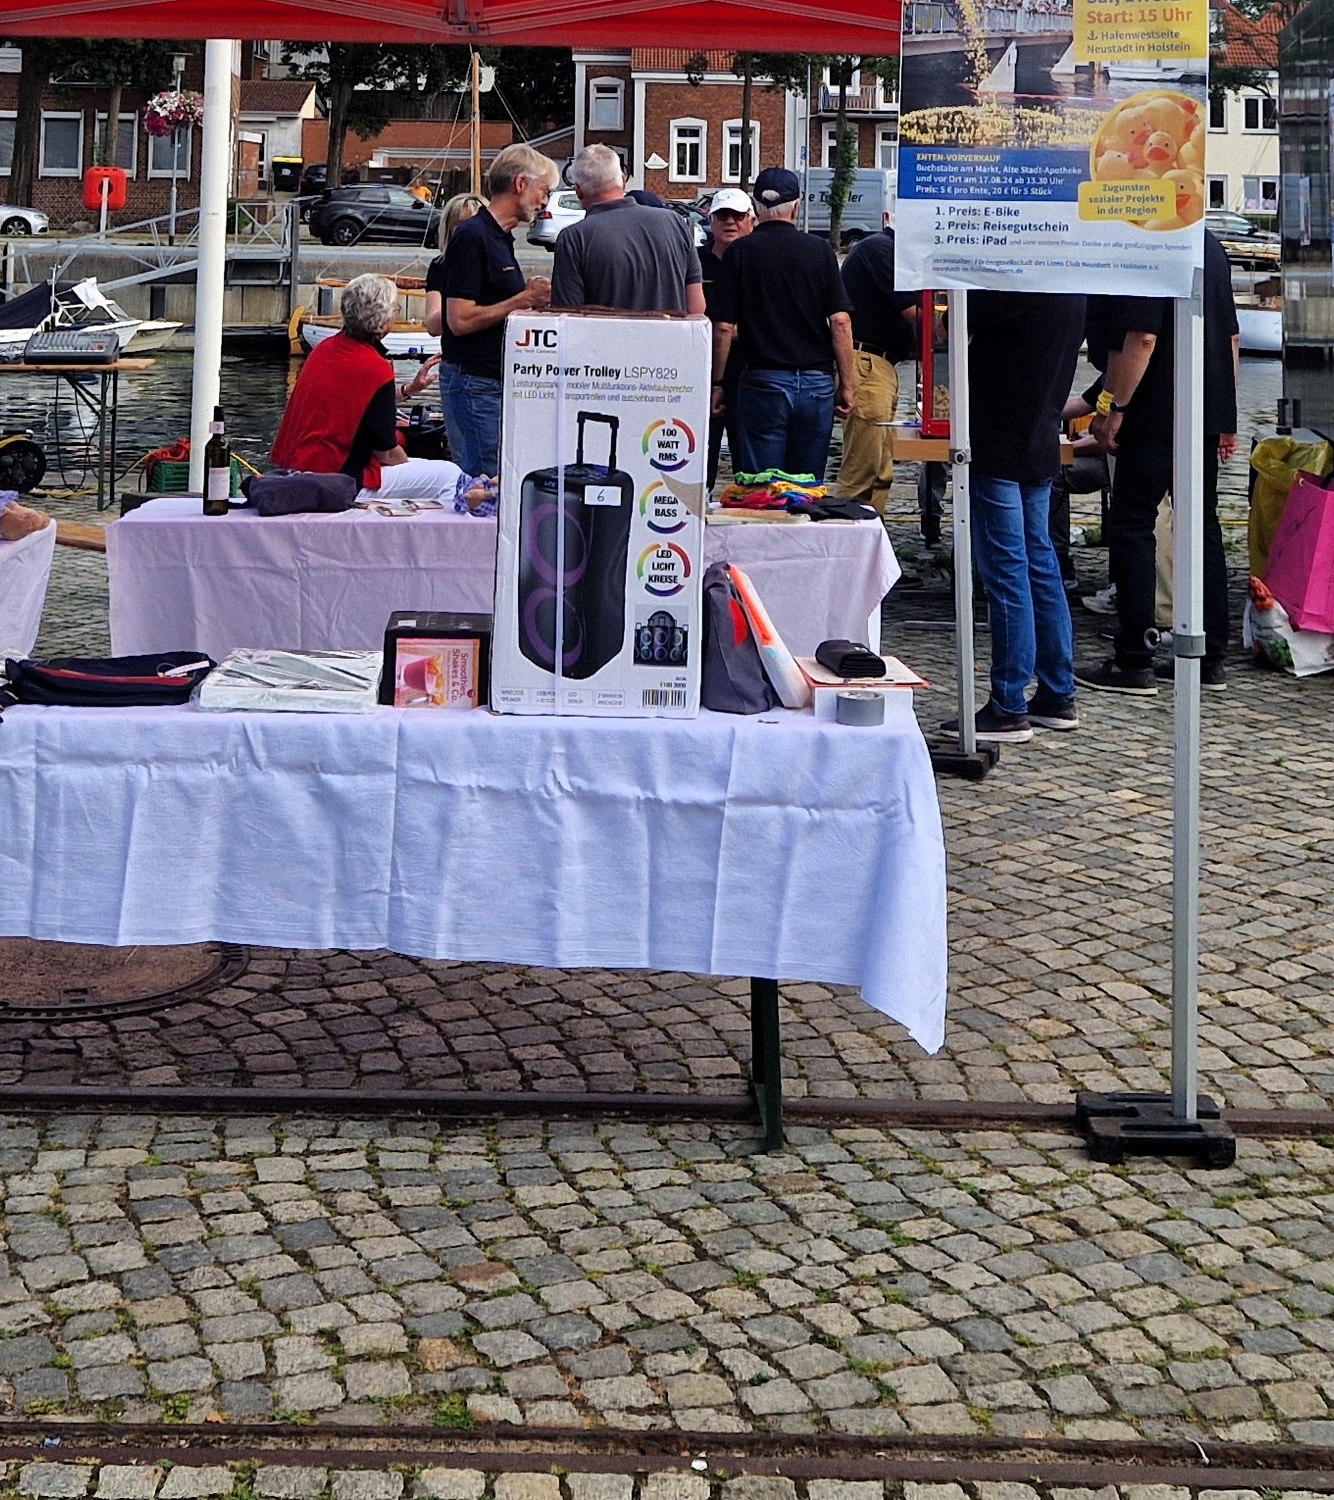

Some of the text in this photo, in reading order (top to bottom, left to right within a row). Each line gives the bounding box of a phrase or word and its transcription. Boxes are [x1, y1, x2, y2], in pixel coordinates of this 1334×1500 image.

[1086, 7, 1193, 25] Start: 15 Uhr
[1100, 30, 1181, 41] Hafenwestseite
[1086, 41, 1191, 54] Neustadt in Holstein
[915, 164, 958, 173] Buchstabe
[975, 165, 1001, 175] Markt,
[1003, 166, 1019, 174] Alte
[1020, 166, 1083, 176] Stadt-Apotheke
[915, 174, 932, 183] und
[933, 176, 947, 184] vor
[948, 175, 962, 184] Ort
[1049, 176, 1065, 185] Uhr
[915, 185, 939, 194] Preis:
[953, 188, 968, 196] pro
[969, 186, 991, 196] Ente,
[992, 186, 1002, 195] 20
[1010, 186, 1023, 196] für
[1030, 186, 1053, 196] Stück
[1102, 183, 1150, 193] Zugunsten
[1089, 194, 1165, 205] sozialer Projekte
[935, 206, 1020, 217] 1. Preis: E-Bike
[1097, 206, 1158, 216] in der Region
[935, 221, 1069, 234] 2. Preis: Reisegutschein
[934, 235, 944, 245] 3.
[946, 235, 980, 245] Preis:
[982, 235, 1008, 246] iPad
[515, 329, 558, 348] JTC
[513, 362, 543, 378] Party
[583, 365, 621, 380] Trolley
[624, 366, 678, 380] LSPY829
[566, 381, 591, 390] mobiler
[524, 390, 538, 399] LED
[607, 394, 620, 402] und
[661, 428, 678, 437] 100
[657, 440, 680, 450] WATT
[658, 452, 678, 462] RMS
[596, 488, 605, 502] 6
[653, 495, 679, 505] MEGA
[654, 508, 678, 518] BASS
[656, 549, 673, 559] LED
[651, 561, 676, 571] LICHT
[648, 574, 679, 584] KREISE
[452, 648, 461, 680] Shakes
[451, 689, 460, 702] Co.
